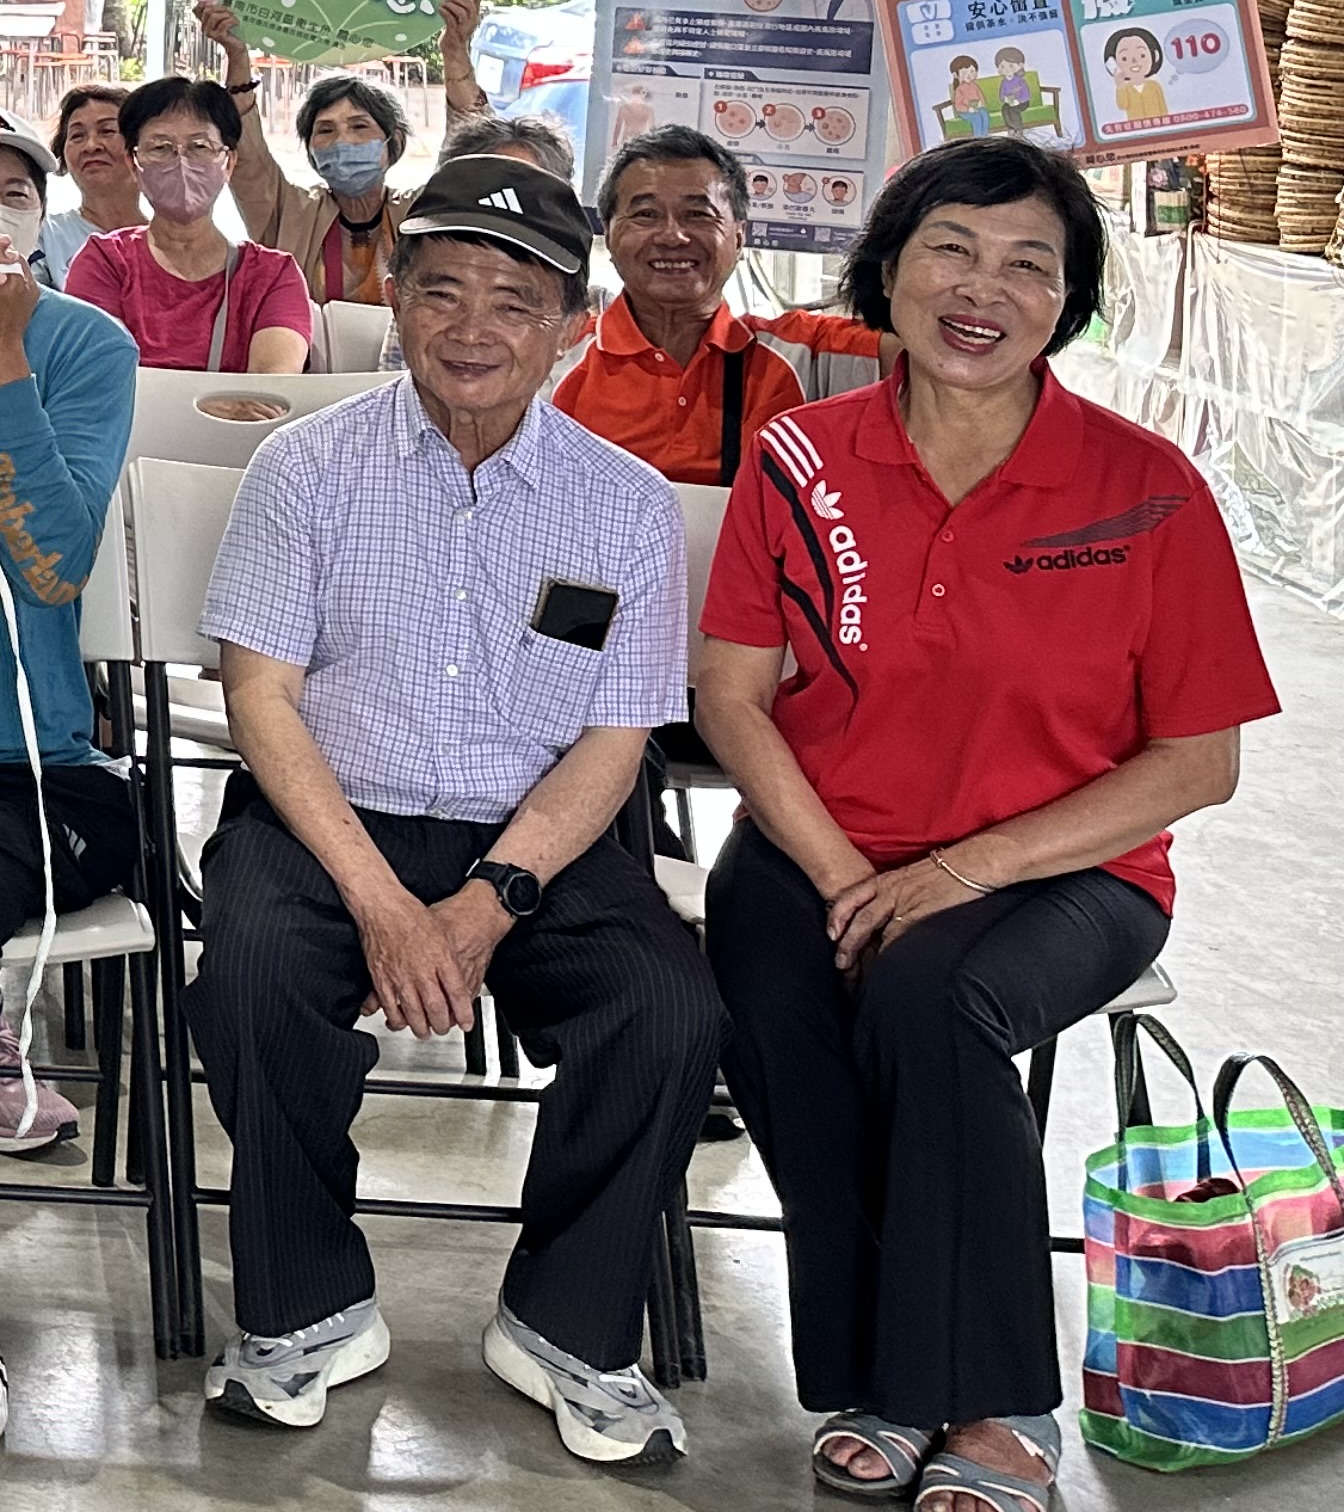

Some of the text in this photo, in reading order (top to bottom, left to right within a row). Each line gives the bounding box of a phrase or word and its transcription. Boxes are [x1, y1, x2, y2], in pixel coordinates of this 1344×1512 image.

[1170, 32, 1222, 60] 110
[1037, 546, 1127, 572] adidas
[828, 524, 869, 646] adidas
